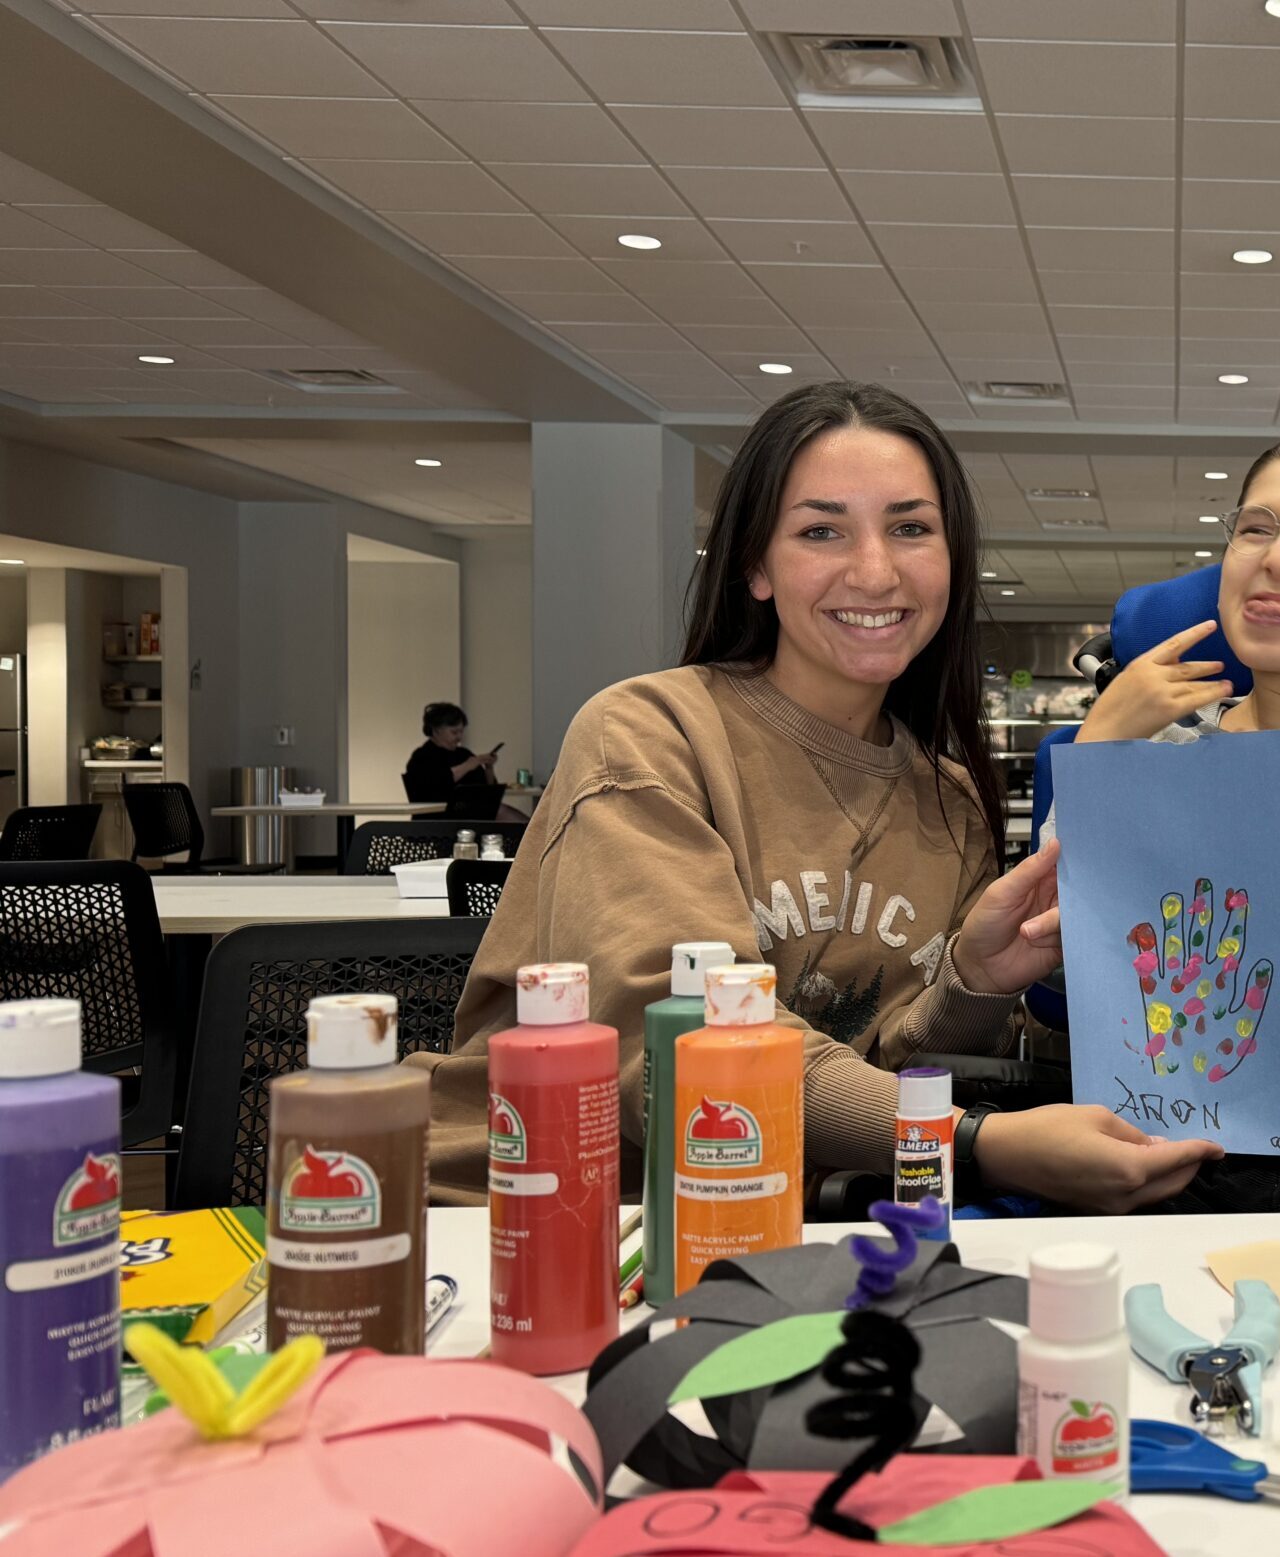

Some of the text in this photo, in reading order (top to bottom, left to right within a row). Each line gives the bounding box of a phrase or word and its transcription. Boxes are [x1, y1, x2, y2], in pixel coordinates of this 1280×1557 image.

[730, 1182, 764, 1193] ORANGE
[738, 1232, 764, 1242] PAINT
[516, 1317, 532, 1332] ml
